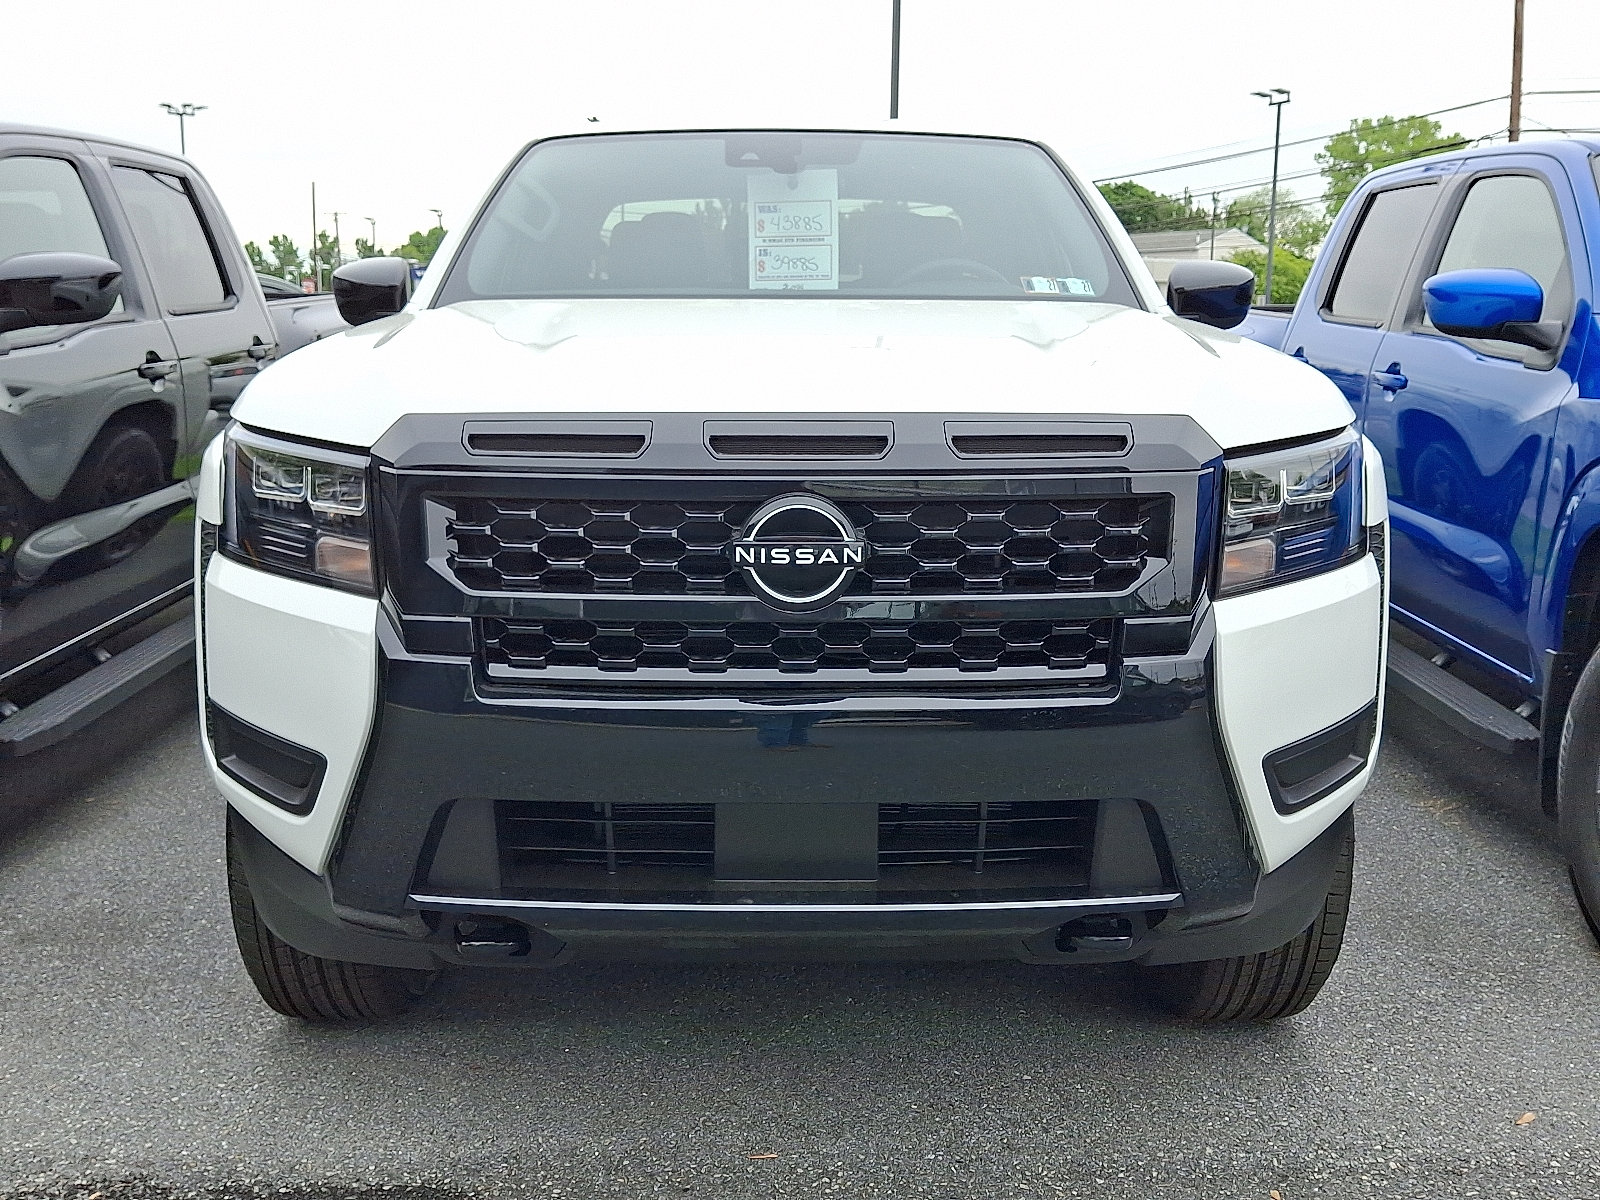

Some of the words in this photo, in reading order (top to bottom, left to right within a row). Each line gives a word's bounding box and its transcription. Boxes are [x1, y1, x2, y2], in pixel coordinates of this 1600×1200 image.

[770, 215, 823, 231] 43885
[771, 255, 819, 271] 39885
[735, 546, 862, 565] NISSAN
